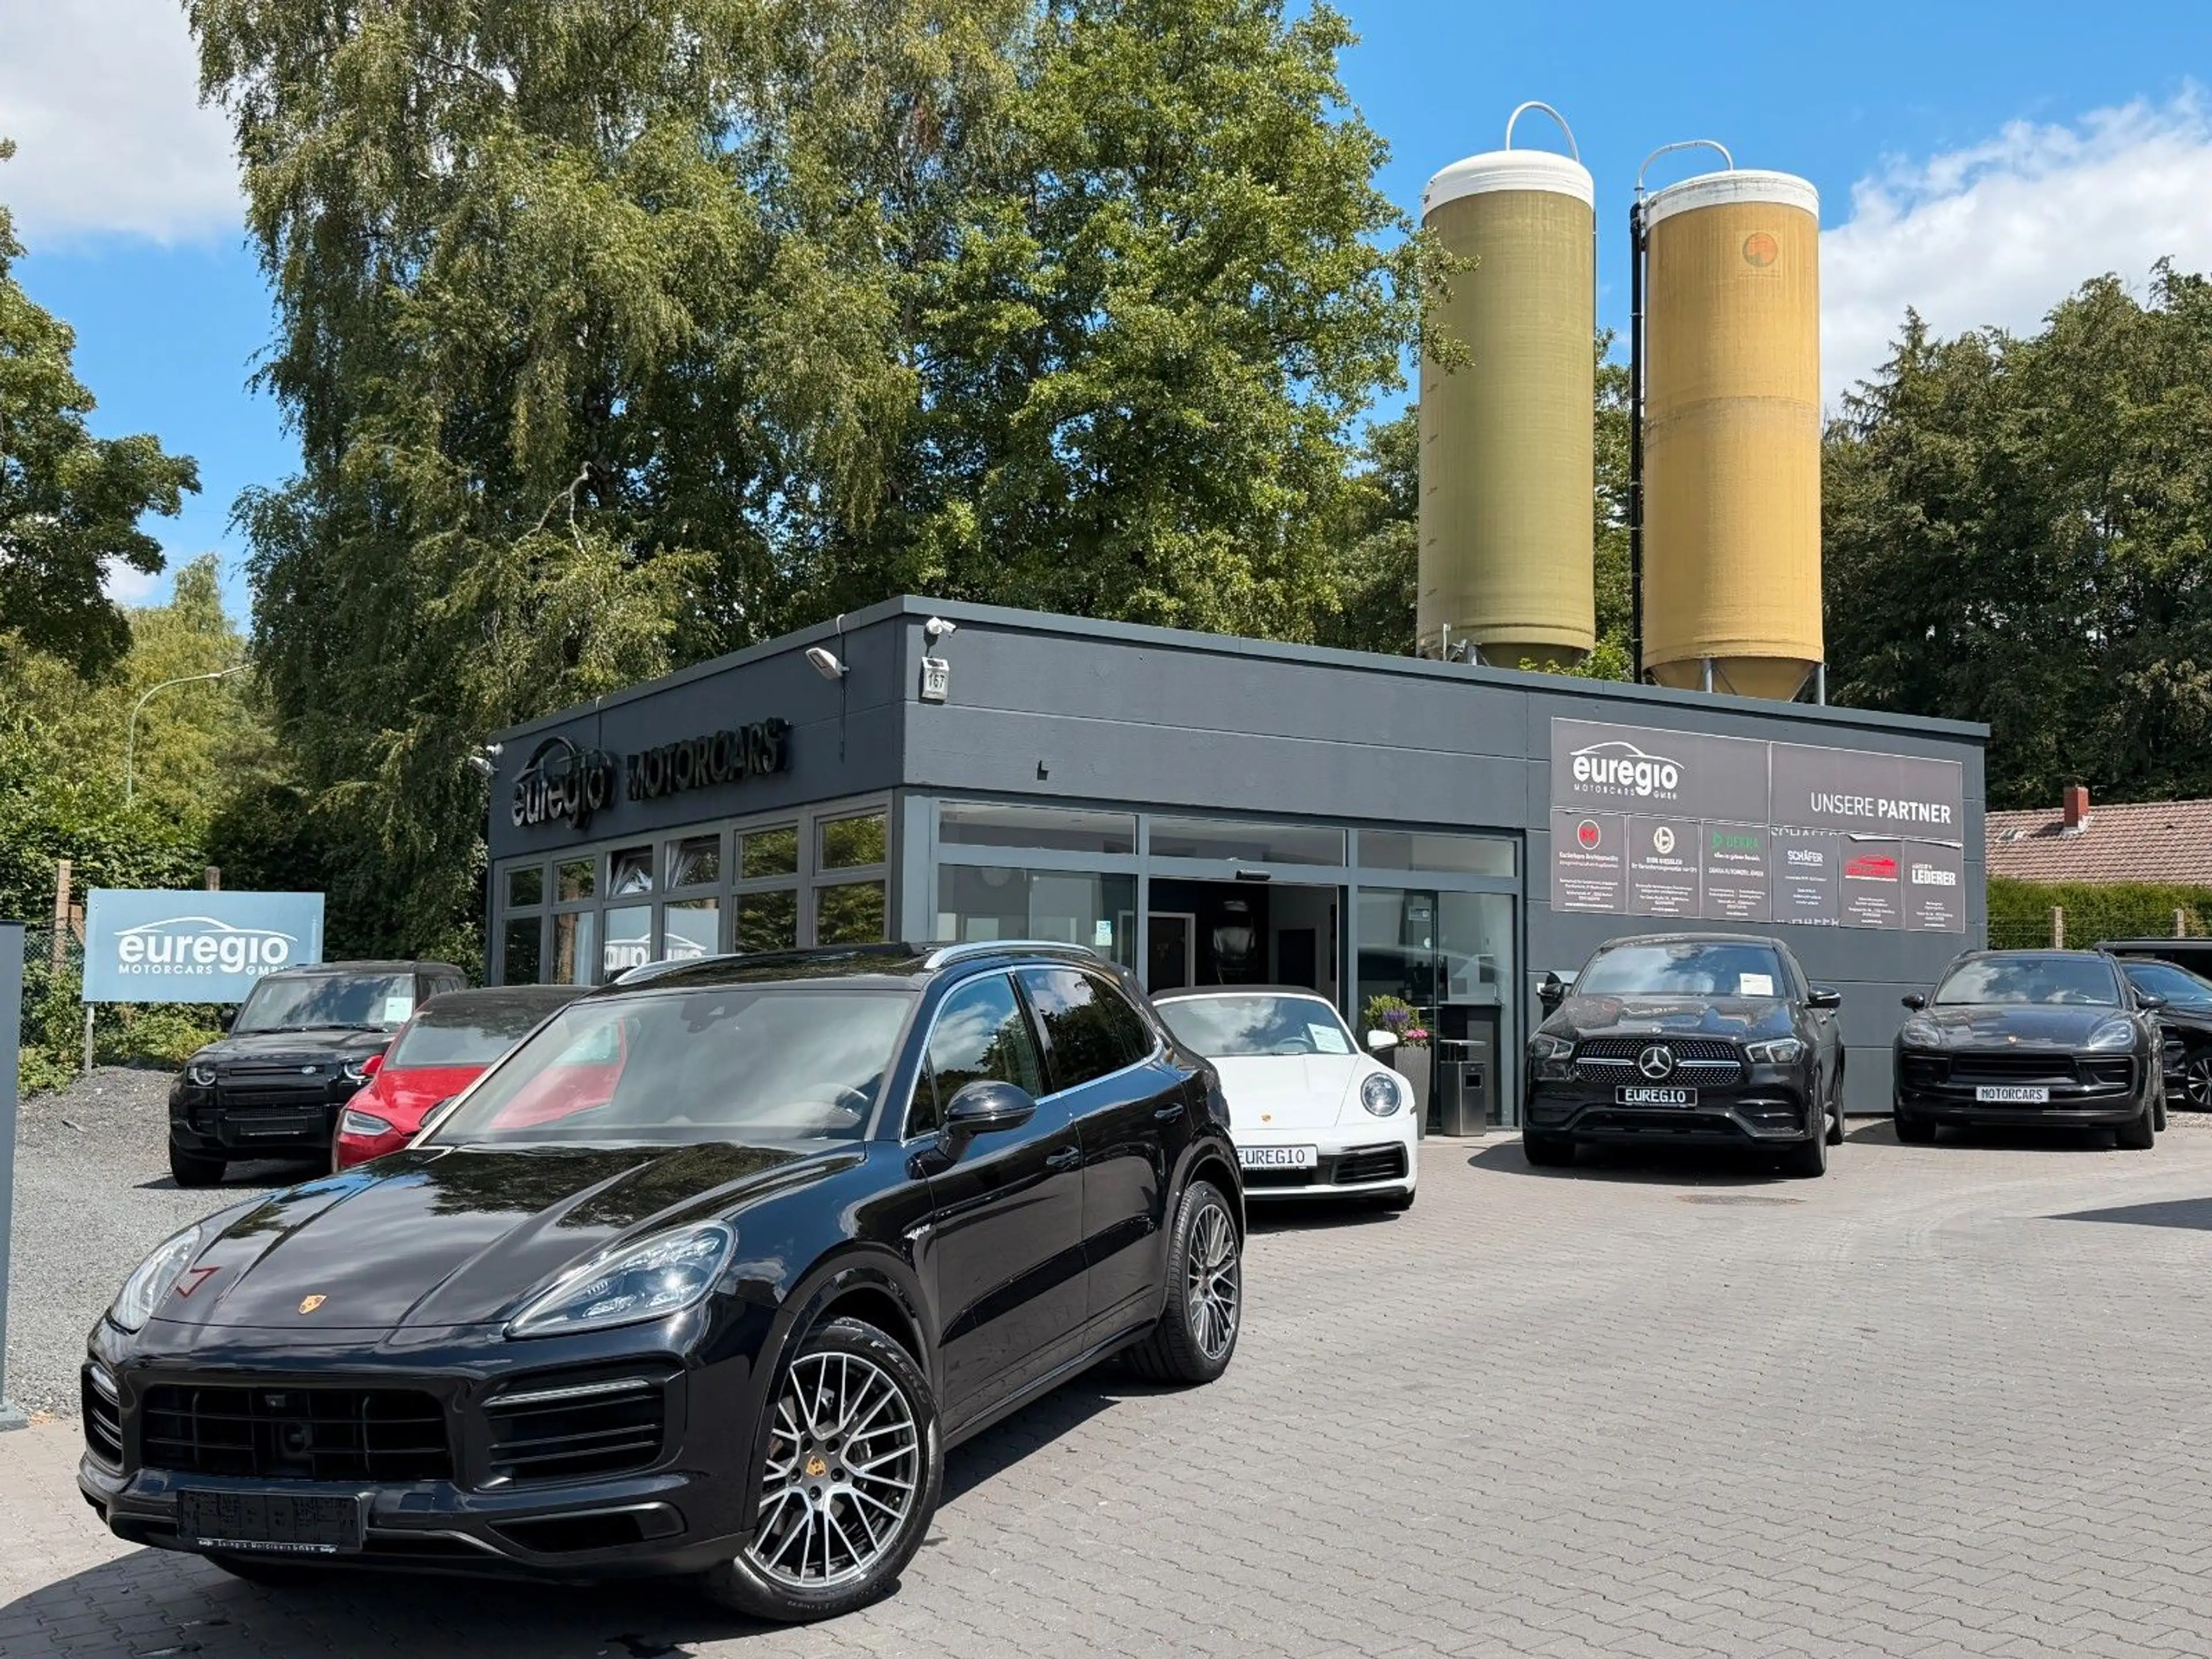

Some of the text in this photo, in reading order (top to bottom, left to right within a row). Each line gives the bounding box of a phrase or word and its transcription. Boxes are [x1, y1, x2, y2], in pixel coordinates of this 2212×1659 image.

[928, 673, 945, 688] 167
[512, 717, 785, 830] euregio MOTORCARS
[1573, 756, 1678, 796] euregio
[1574, 784, 1635, 797] MOTORCARS
[1810, 792, 1951, 824] UNSERE PARTNER
[1787, 850, 1824, 863] SCHÄFER
[1911, 869, 1956, 885] LEDERER
[118, 934, 288, 973] euregio
[118, 964, 288, 976] MOTORCARS GMB
[1625, 1089, 1686, 1103] EUREGIO
[1982, 1088, 2043, 1100] MOTORCARS
